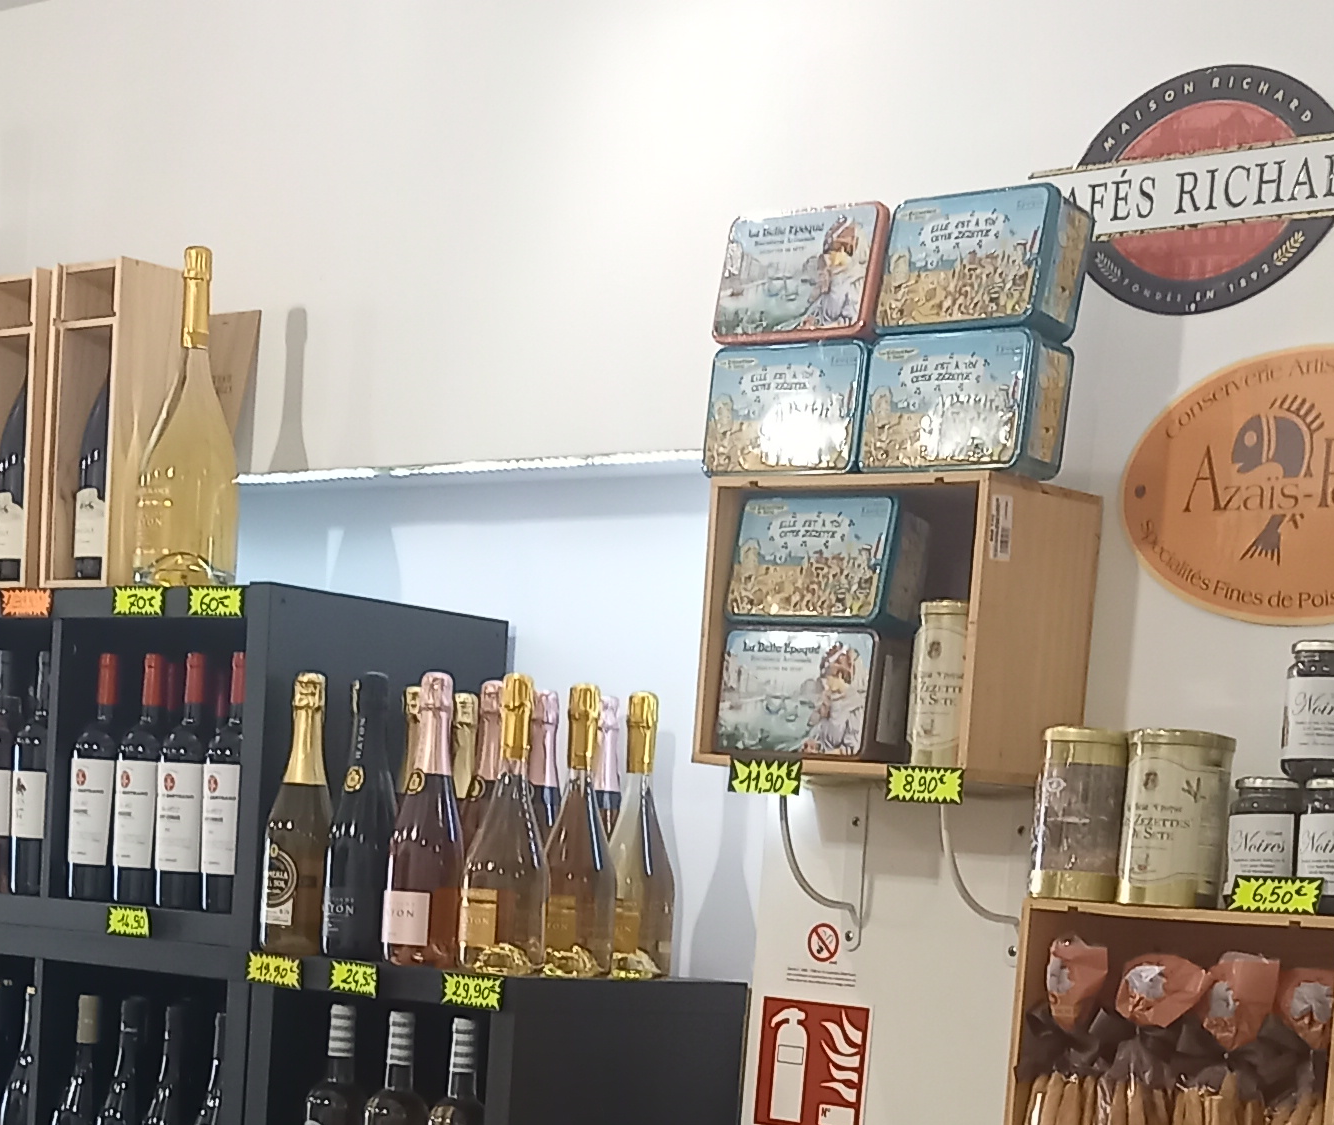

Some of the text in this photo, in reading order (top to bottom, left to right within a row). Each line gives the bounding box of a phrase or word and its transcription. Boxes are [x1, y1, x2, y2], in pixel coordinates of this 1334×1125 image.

[1101, 73, 1314, 152] MAISON RICHARD
[1065, 168, 1157, 222] AFÉS
[1165, 363, 1278, 440] Conserverie
[1139, 517, 1211, 593] Spécialités
[1213, 577, 1264, 608] Fines
[1267, 588, 1294, 611] de
[200, 593, 231, 613] 60€
[739, 767, 798, 795] 11,90€
[902, 773, 947, 793] 8,90€
[1232, 830, 1286, 853] Noires
[1251, 884, 1308, 905] 6,50€
[453, 981, 498, 1004] 29,90€
